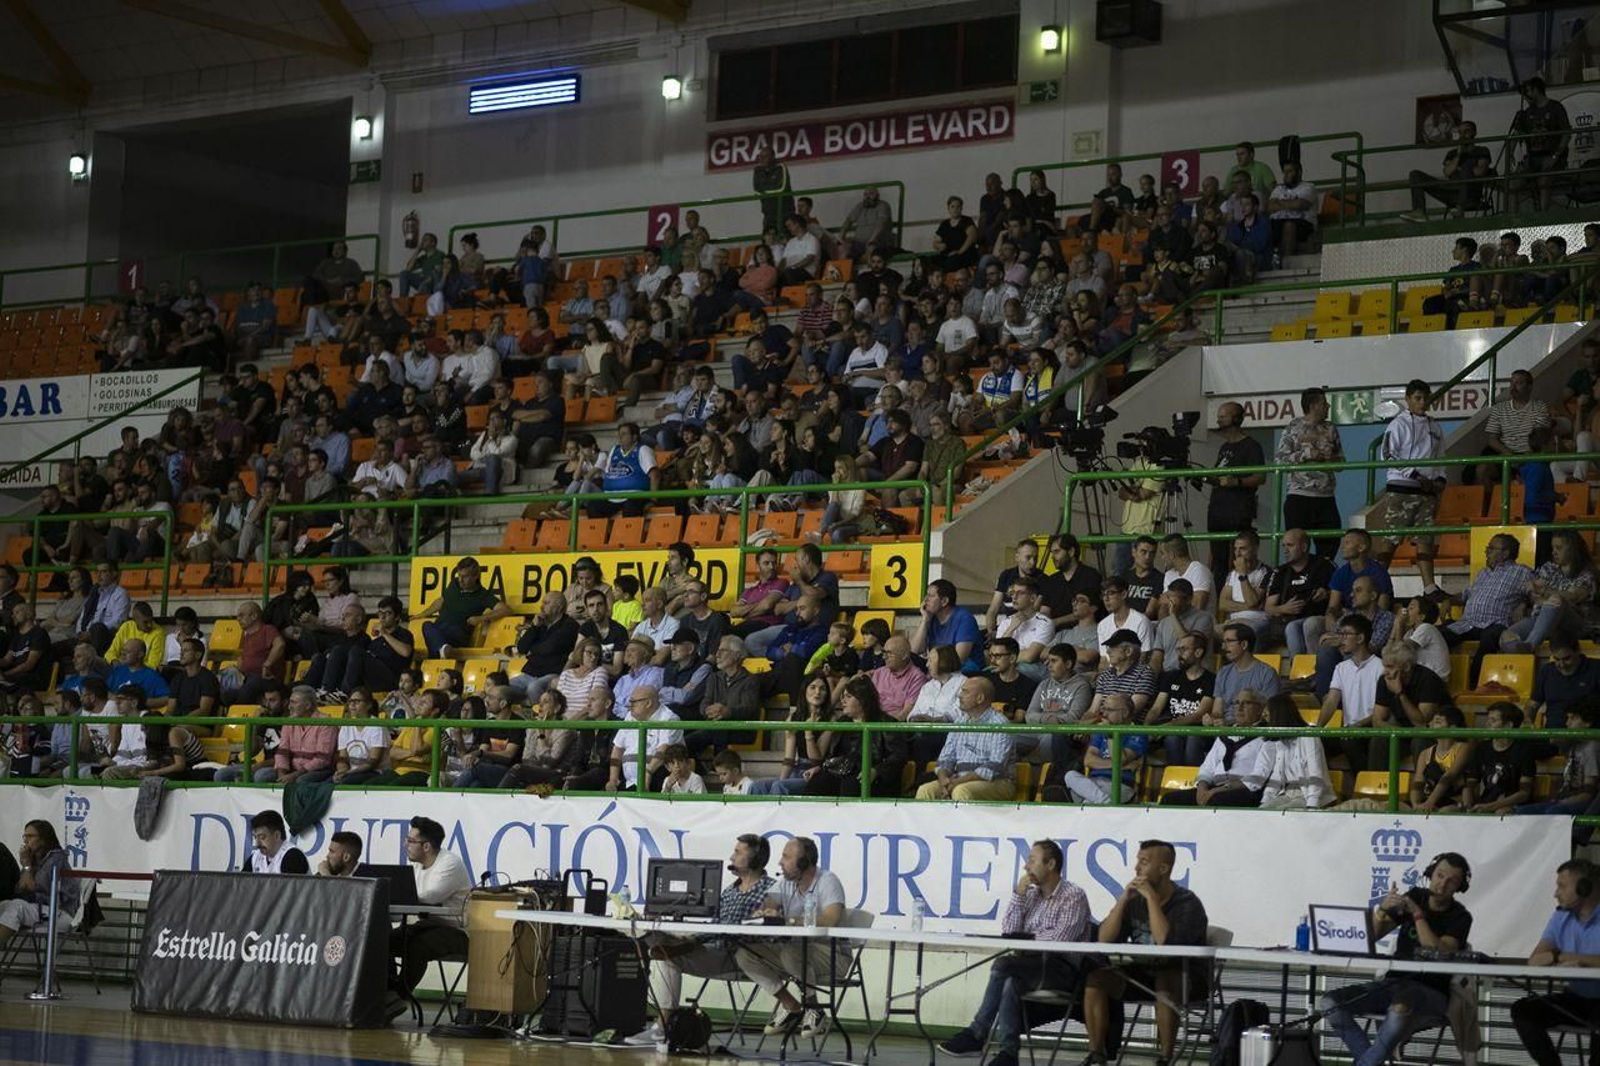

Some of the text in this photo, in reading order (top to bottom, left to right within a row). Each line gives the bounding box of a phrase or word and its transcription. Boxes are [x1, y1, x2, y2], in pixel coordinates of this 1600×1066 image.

[709, 105, 1010, 166] GRADA BOULEVARD
[1170, 158, 1189, 190] 3
[655, 212, 671, 241] 2
[128, 264, 137, 290] 1
[99, 388, 152, 400] GOLOSINAS
[100, 374, 159, 387] BOCADILLOS
[884, 555, 908, 598] 3
[151, 927, 318, 965] Estrella Galicia
